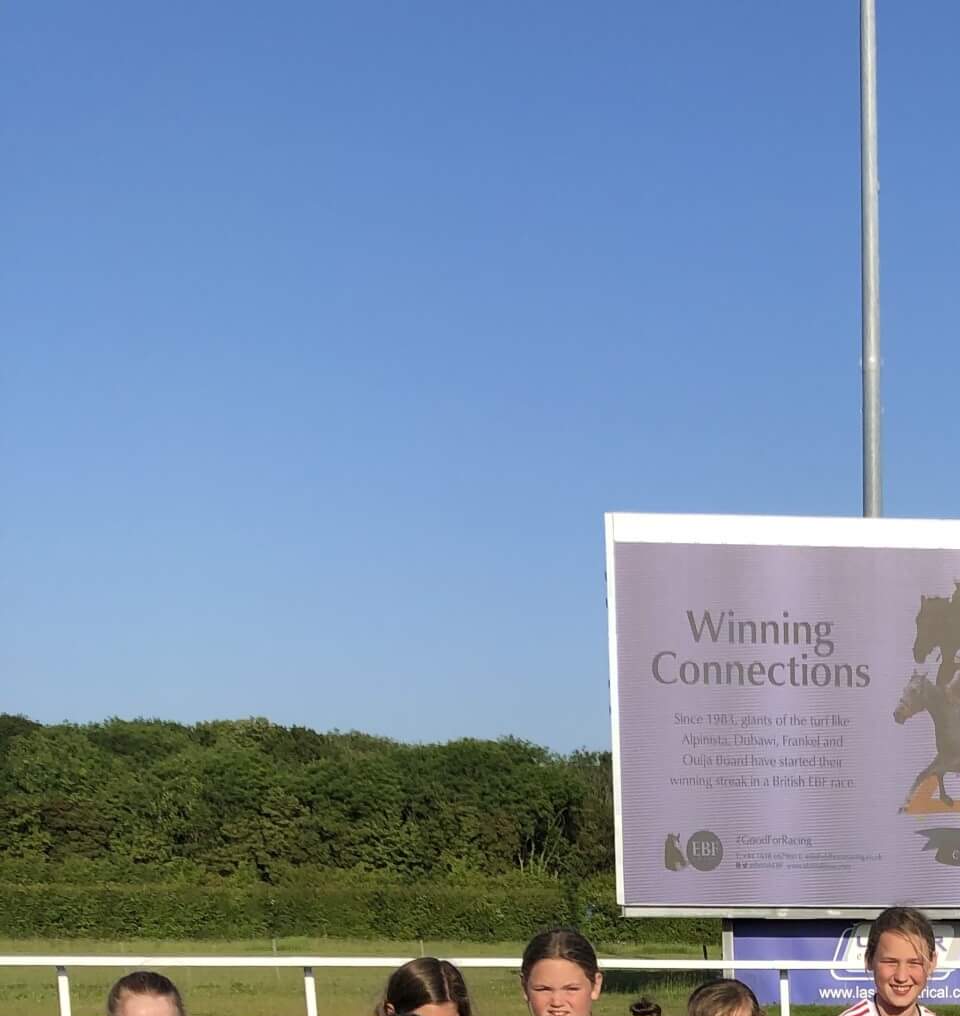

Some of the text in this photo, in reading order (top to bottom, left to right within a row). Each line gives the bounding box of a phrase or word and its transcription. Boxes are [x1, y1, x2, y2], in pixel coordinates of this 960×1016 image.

[686, 608, 835, 657] Winning
[651, 650, 871, 688] Connections
[673, 712, 704, 726] Since
[740, 713, 773, 729] giants
[775, 713, 788, 727] of
[789, 713, 807, 727] the
[810, 714, 832, 728] turf
[832, 713, 851, 728] like
[782, 734, 821, 748] Frankel
[822, 735, 844, 748] and
[682, 753, 842, 769] Ouija Board have started their
[669, 775, 713, 789] winning
[715, 775, 747, 788] streak
[750, 775, 760, 787] in
[772, 775, 806, 788] British
[808, 776, 828, 787] EBF
[692, 840, 718, 858] EBF
